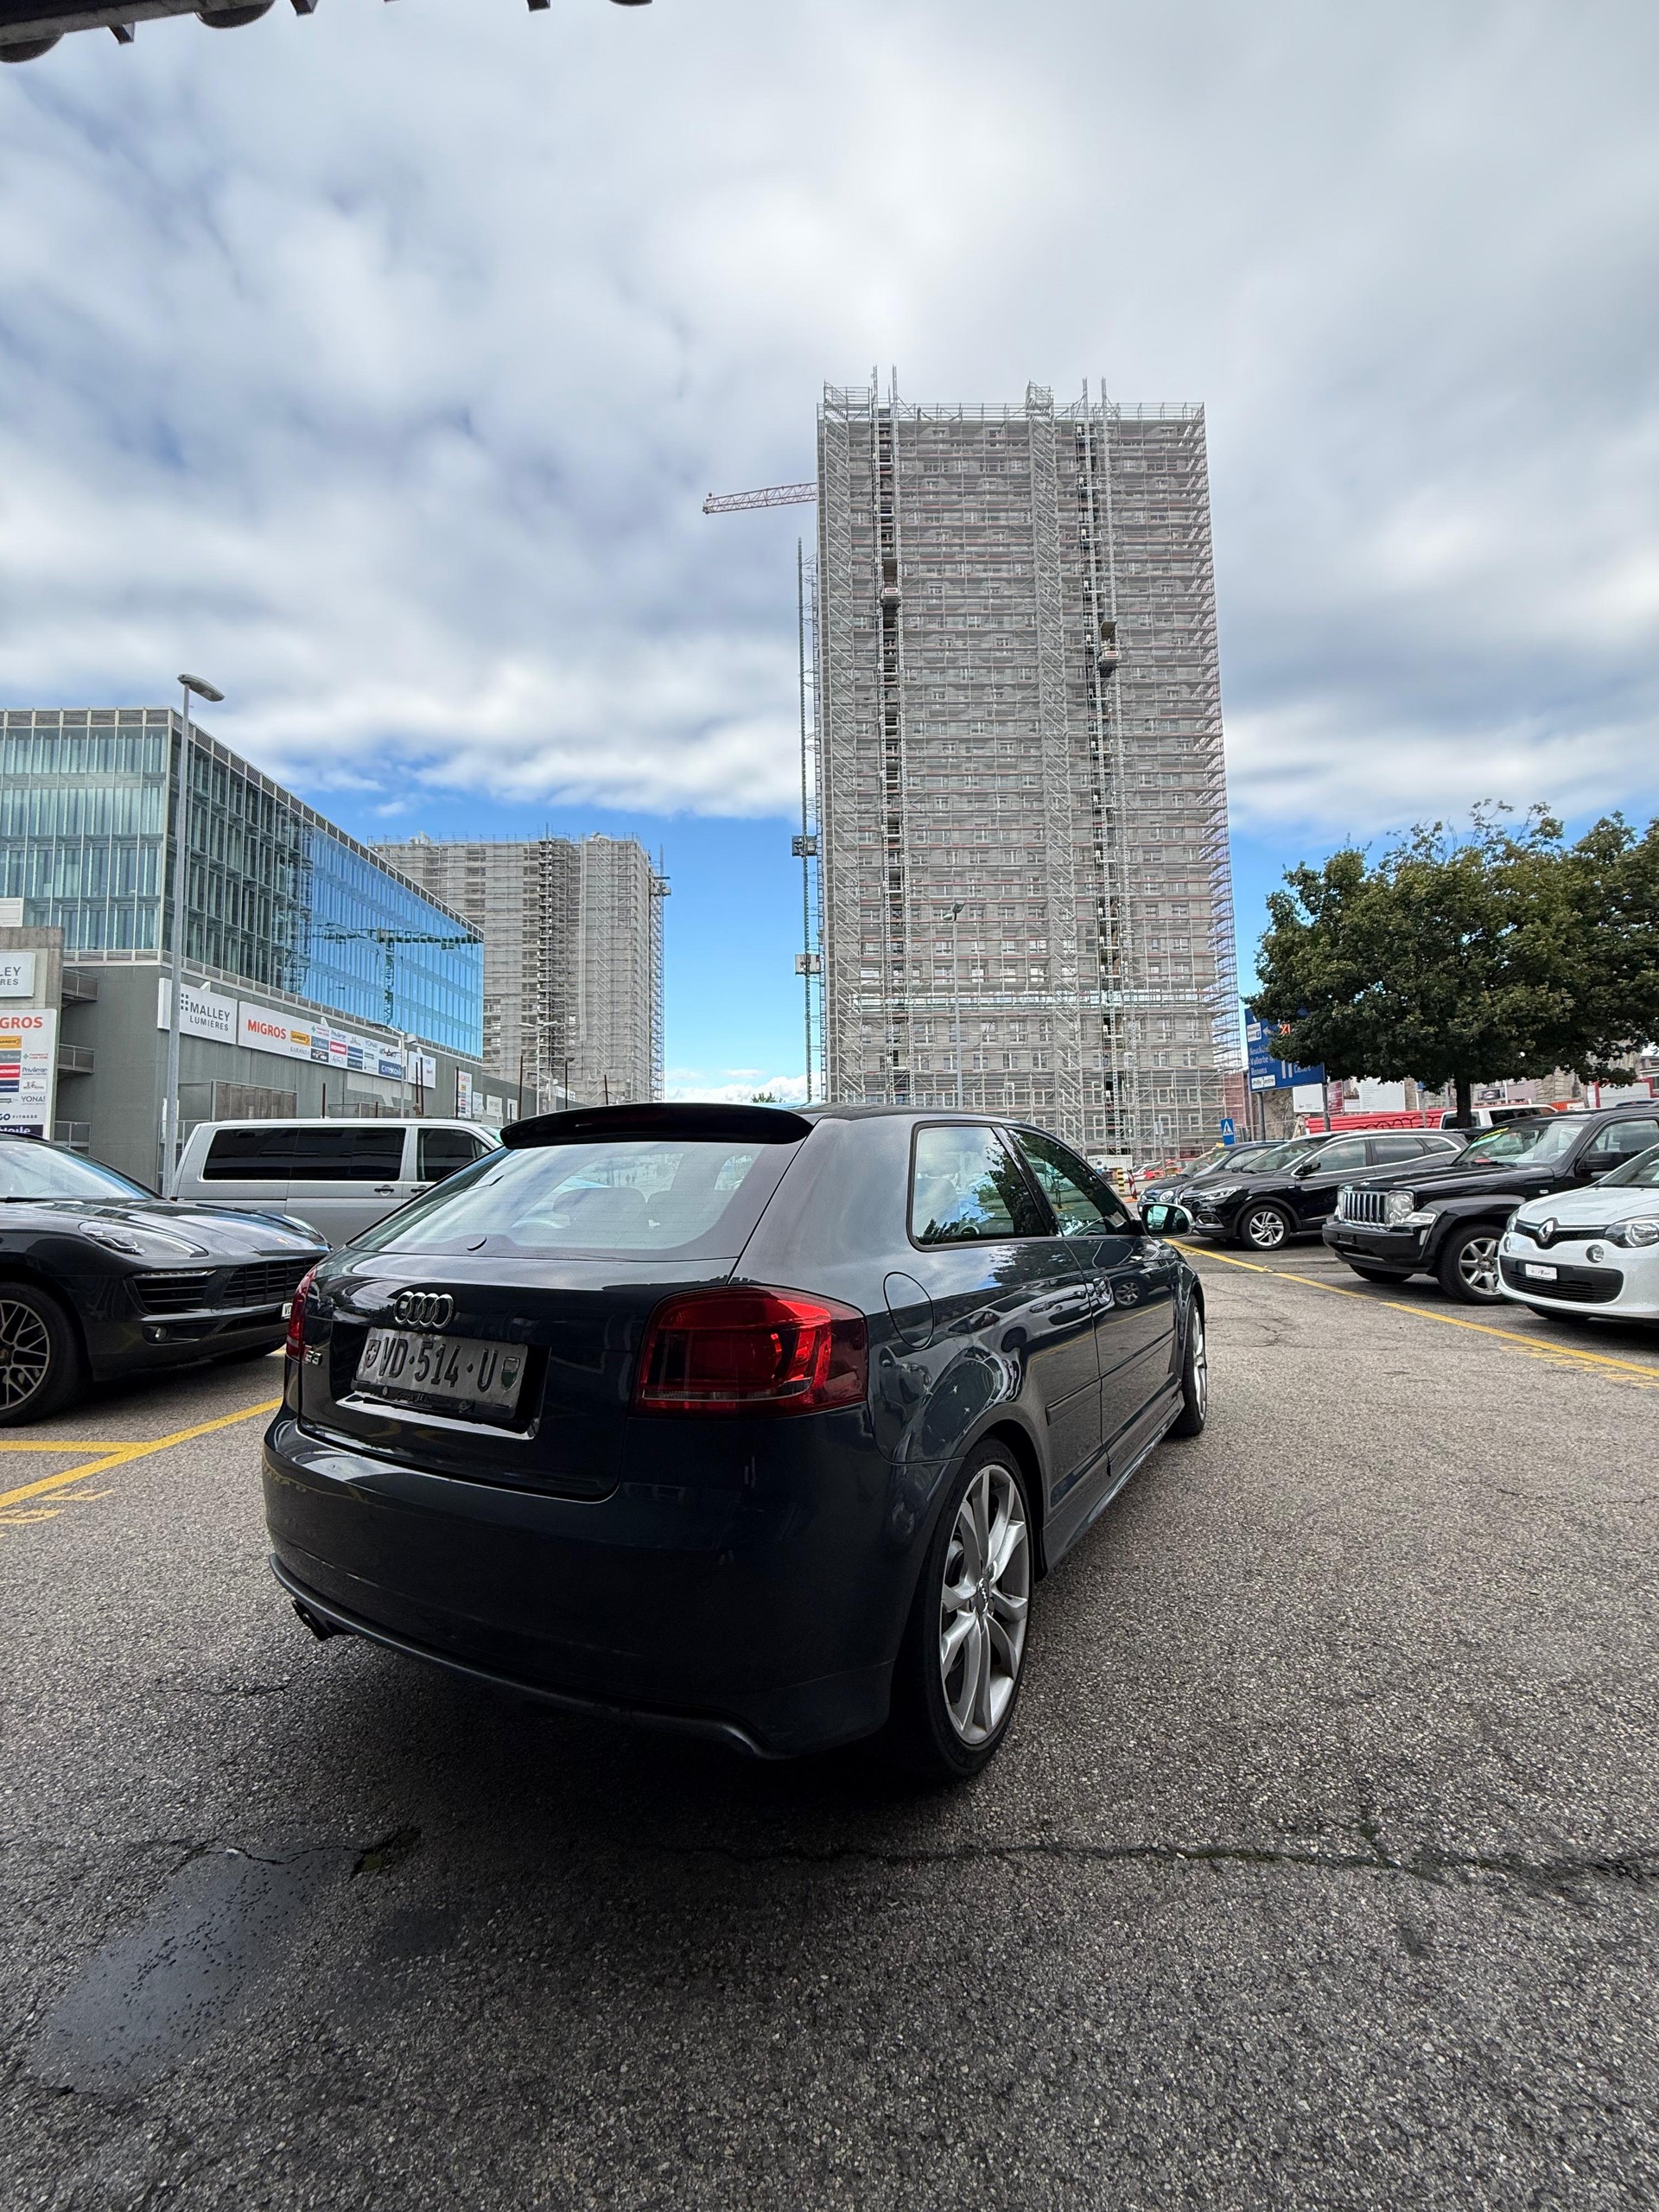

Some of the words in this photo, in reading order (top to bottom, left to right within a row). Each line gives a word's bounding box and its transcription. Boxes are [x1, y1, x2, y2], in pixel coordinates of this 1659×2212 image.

[190, 1001, 231, 1022] MALLEY
[0, 1016, 43, 1029] GROS
[189, 1014, 229, 1032] LUMIÈRES
[247, 1019, 287, 1040] MIGROS
[1251, 1067, 1268, 1076] Renens
